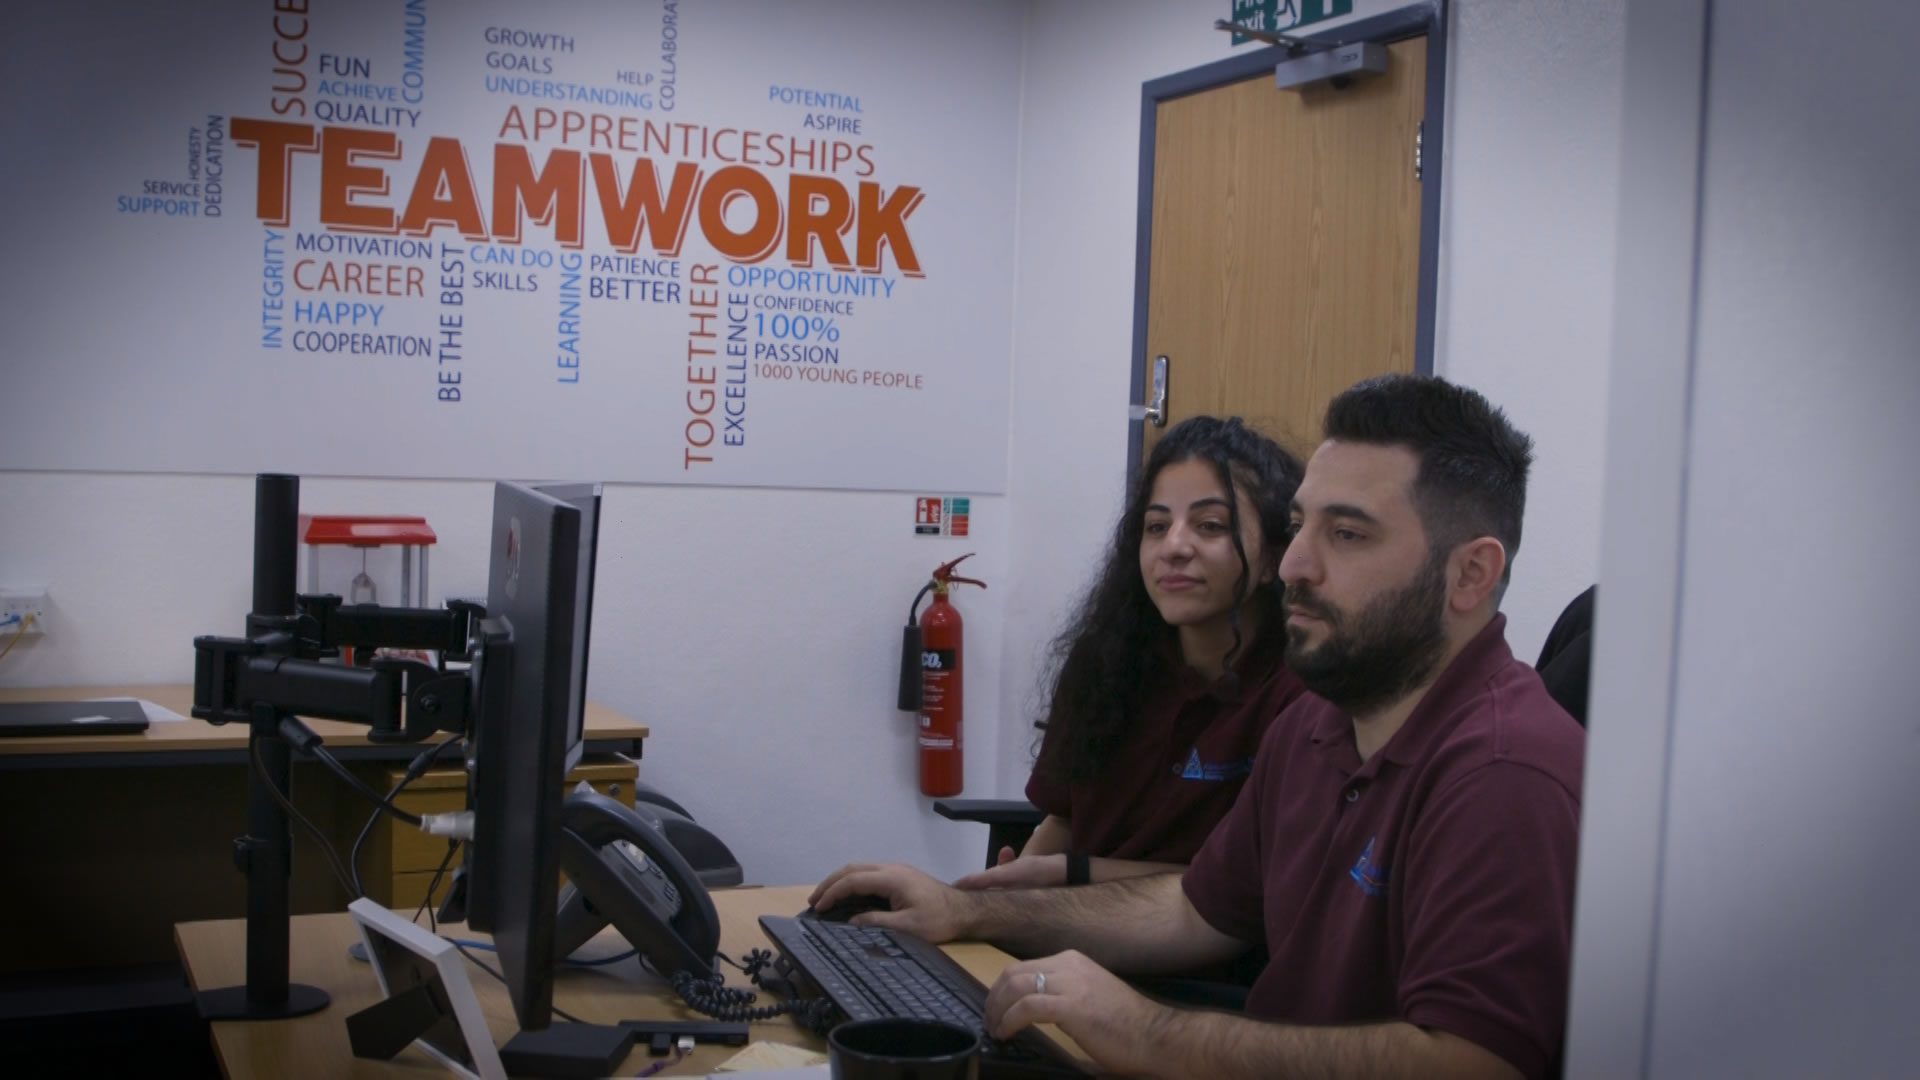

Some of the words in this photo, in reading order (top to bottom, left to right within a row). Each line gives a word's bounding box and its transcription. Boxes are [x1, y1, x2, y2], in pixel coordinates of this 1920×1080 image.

[485, 27, 574, 53] GROWTH
[319, 54, 370, 78] FUN
[486, 51, 553, 74] GOALS
[659, 0, 679, 111] COLLABORA
[318, 79, 397, 101] ACHIEVE
[617, 70, 654, 86] HELP
[485, 76, 653, 110] UNDERSTANDING
[769, 86, 863, 113] POTENTIAL
[315, 100, 421, 128] QUALITY
[803, 113, 862, 135] ASPIRE
[189, 127, 201, 180] HONESTY
[500, 105, 875, 177] APPRENTICESHIPS
[204, 115, 224, 217] DEDICATION
[143, 180, 200, 198] SERVICE
[230, 117, 926, 278] TEAMWORK
[117, 196, 200, 217] SUPPORT
[296, 233, 432, 260] MOTIVATION
[470, 245, 515, 265] CAN
[521, 248, 553, 268] DO
[293, 259, 425, 297] CAREER
[440, 241, 465, 306] BEST
[590, 255, 681, 278] PATIENCE
[262, 229, 286, 348] INTEGRITY
[473, 271, 538, 292] SKILLS
[589, 277, 681, 303] BETTER
[728, 265, 896, 298] OPPORTUNITY
[294, 301, 384, 327] HAPPY
[557, 253, 583, 384] LEARNING
[753, 294, 855, 316] CONFIDENCE
[439, 313, 463, 365] THE
[754, 312, 840, 342] 100%
[293, 330, 431, 357] COOPERATION
[754, 343, 839, 364] PASSION
[685, 263, 720, 470] TOGETHER
[724, 293, 748, 446] EXCELLENCE
[753, 363, 793, 381] 1000
[797, 365, 858, 385] YOUNG
[862, 370, 924, 390] PEOPLE
[438, 371, 462, 402] BE
